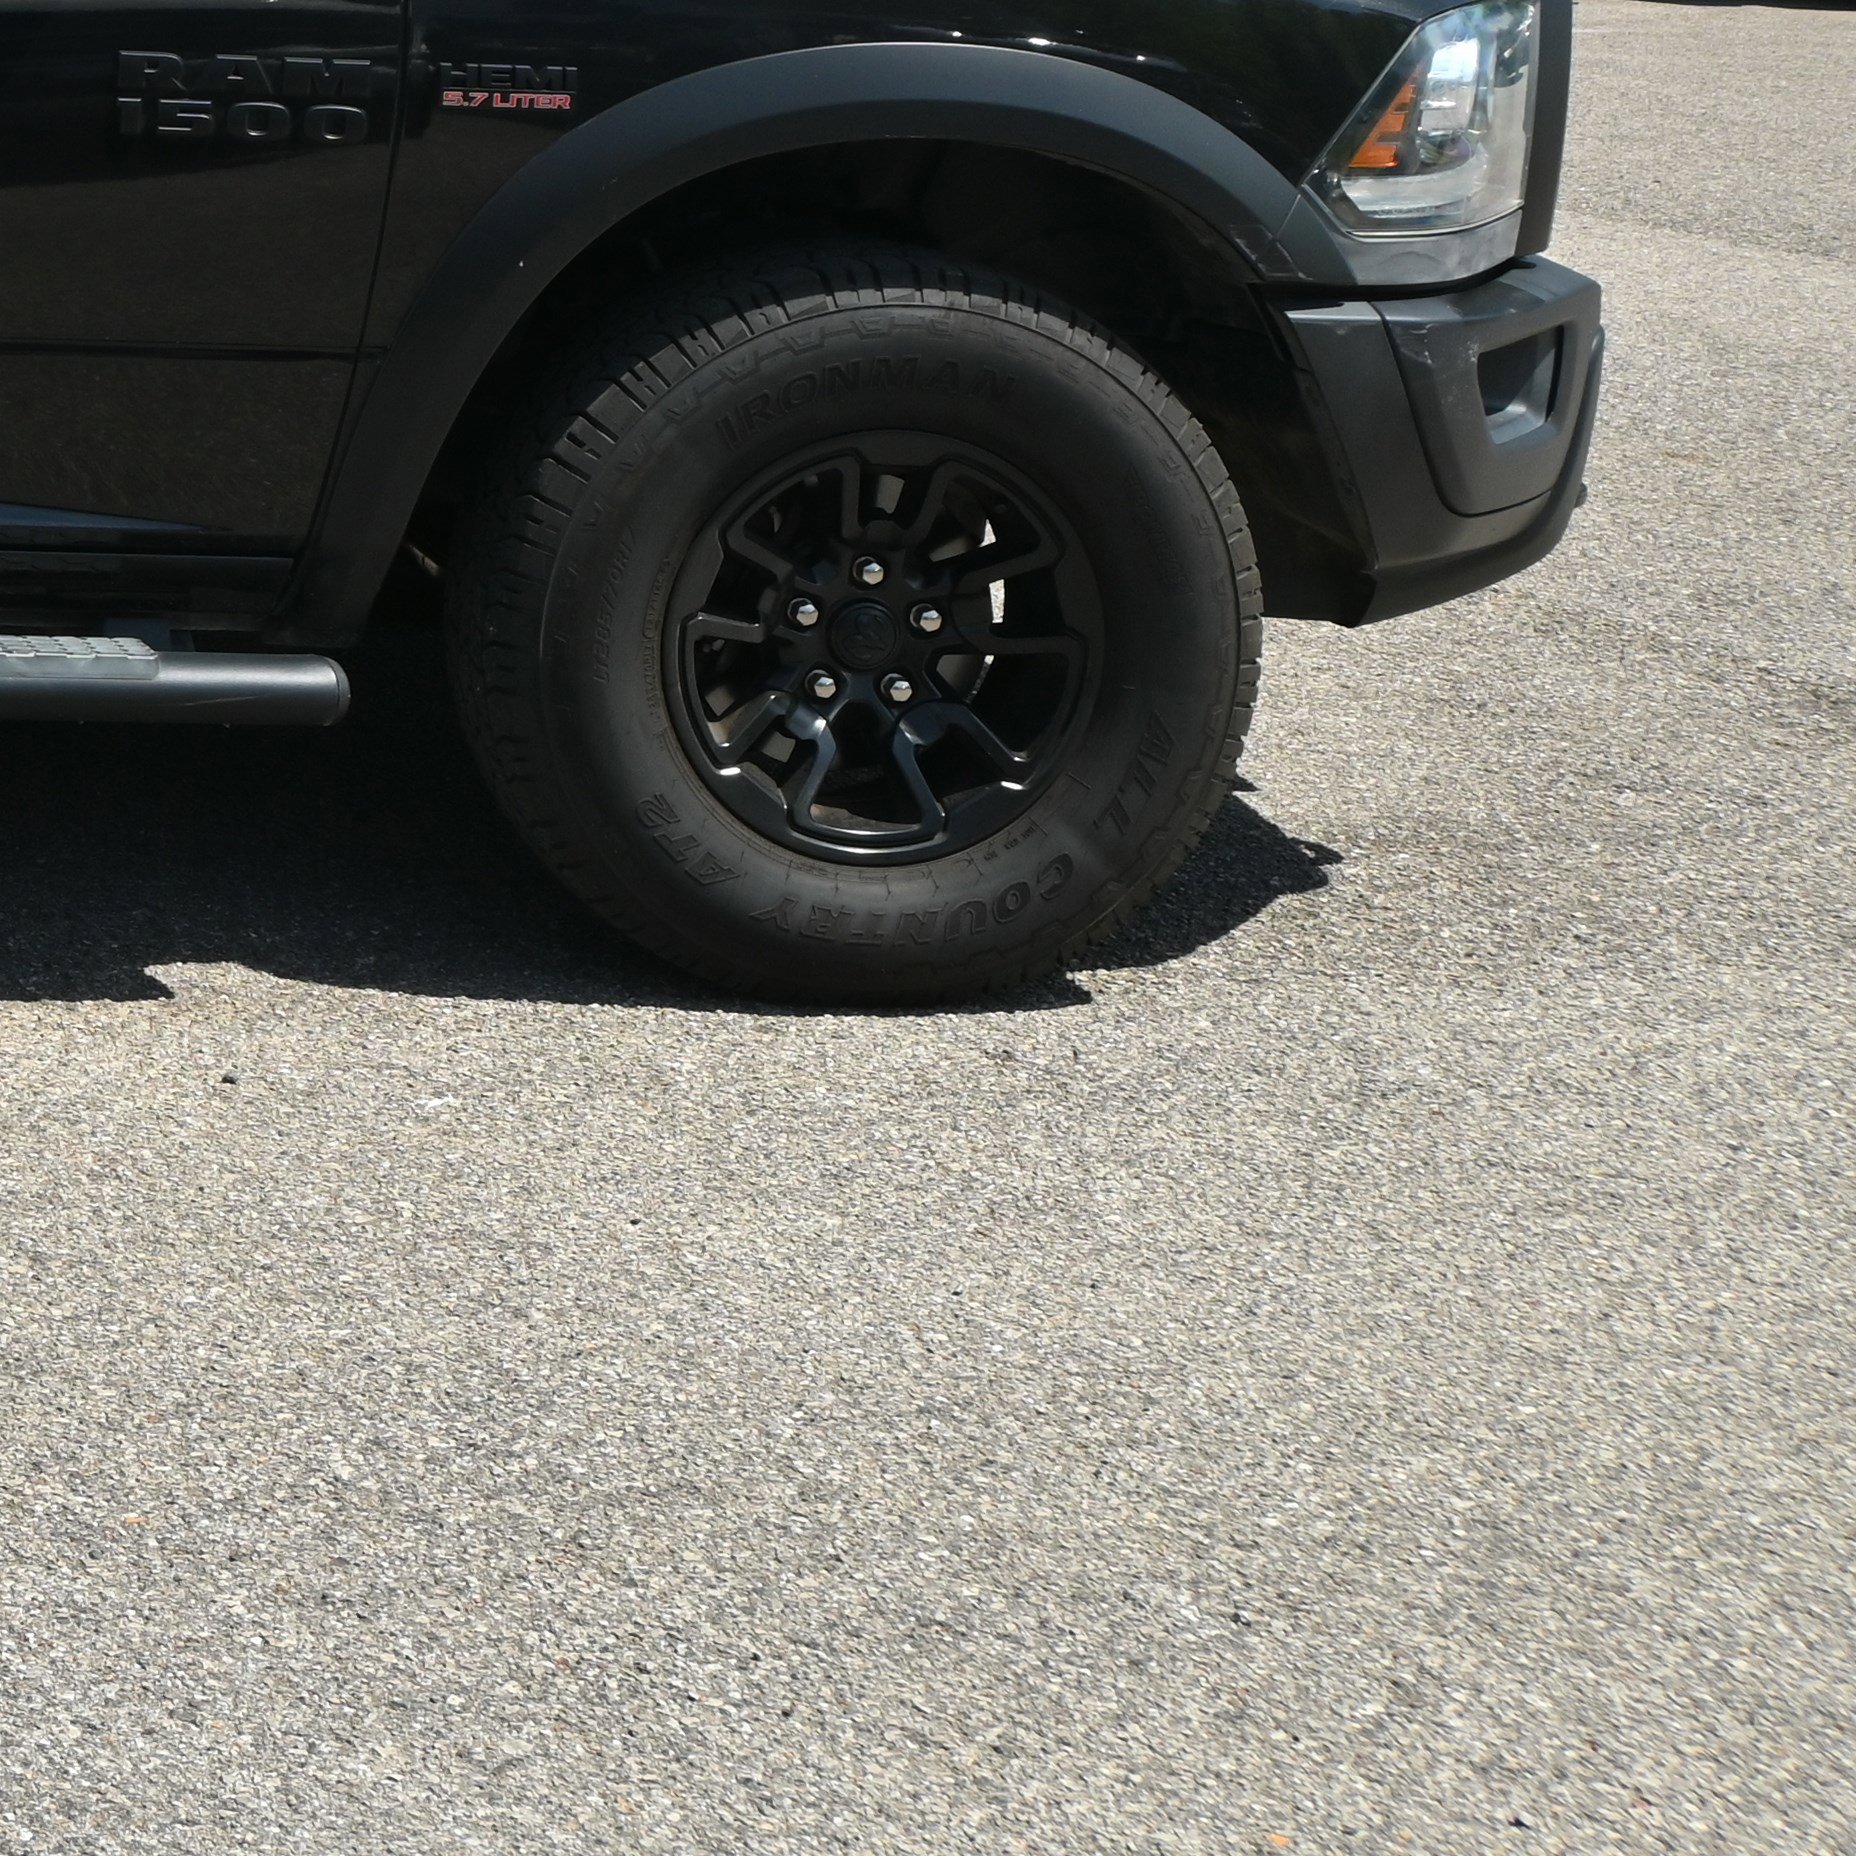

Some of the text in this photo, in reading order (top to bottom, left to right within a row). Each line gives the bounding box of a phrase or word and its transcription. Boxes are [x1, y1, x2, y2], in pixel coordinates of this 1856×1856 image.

[117, 49, 372, 96] RAM
[439, 61, 579, 91] HEMI
[117, 97, 370, 143] 1500
[442, 91, 573, 110] 5.7 LITER
[714, 354, 1020, 451] IRONMAN
[634, 791, 743, 889] AT2
[748, 852, 1077, 950] COUNTRY
